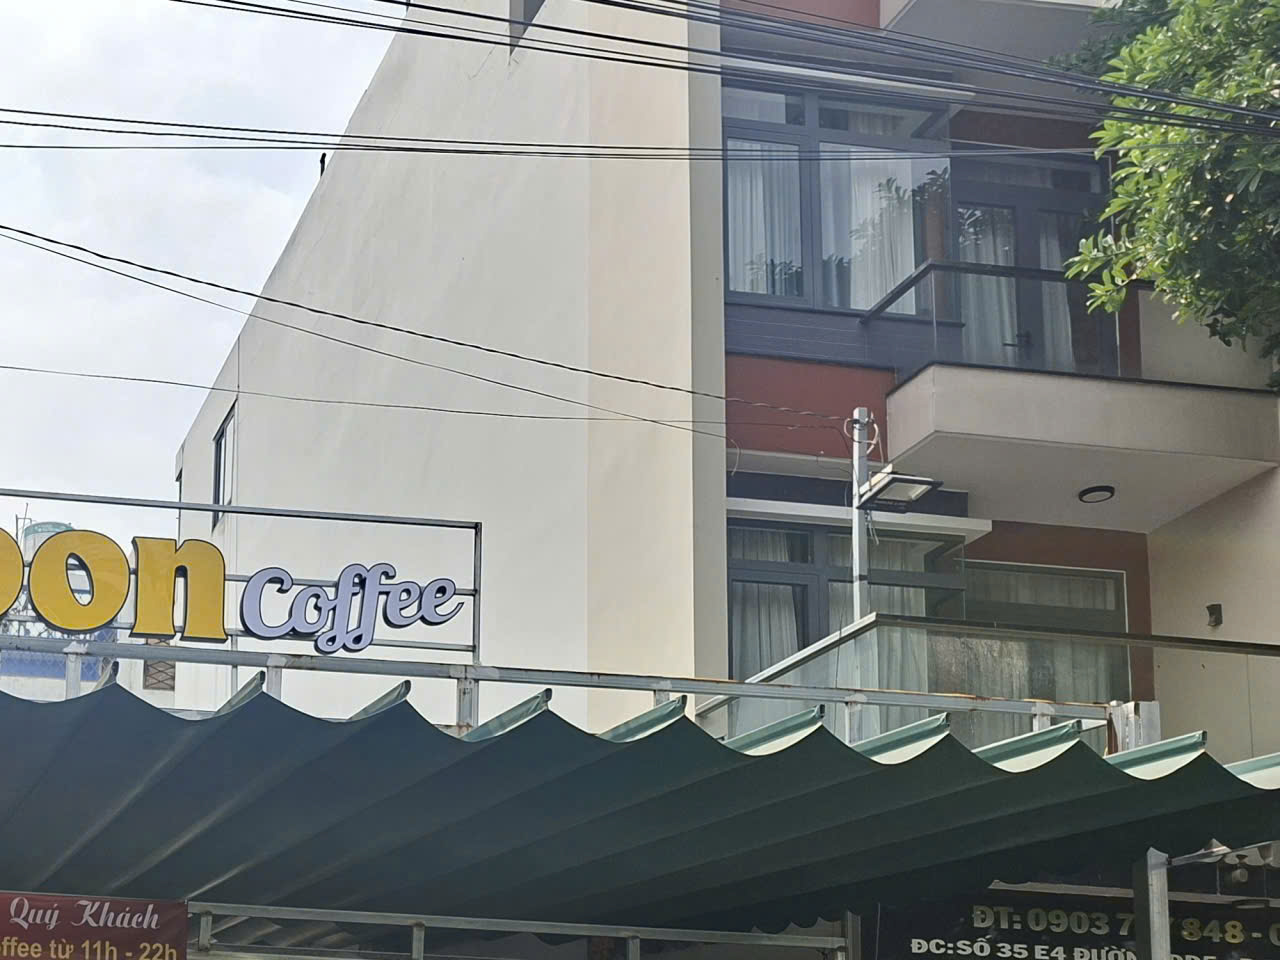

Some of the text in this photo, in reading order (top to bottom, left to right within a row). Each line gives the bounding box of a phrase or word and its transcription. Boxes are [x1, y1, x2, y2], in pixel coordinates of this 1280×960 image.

[239, 562, 465, 654] Coffee
[8, 896, 60, 931] Quý
[71, 899, 160, 930] Khách
[972, 905, 1022, 930] ĐT:
[1027, 908, 1110, 936] 0903
[1181, 917, 1246, 944] 848
[49, 938, 75, 960] từ
[996, 943, 1029, 959] 35
[1034, 945, 1066, 960] E4
